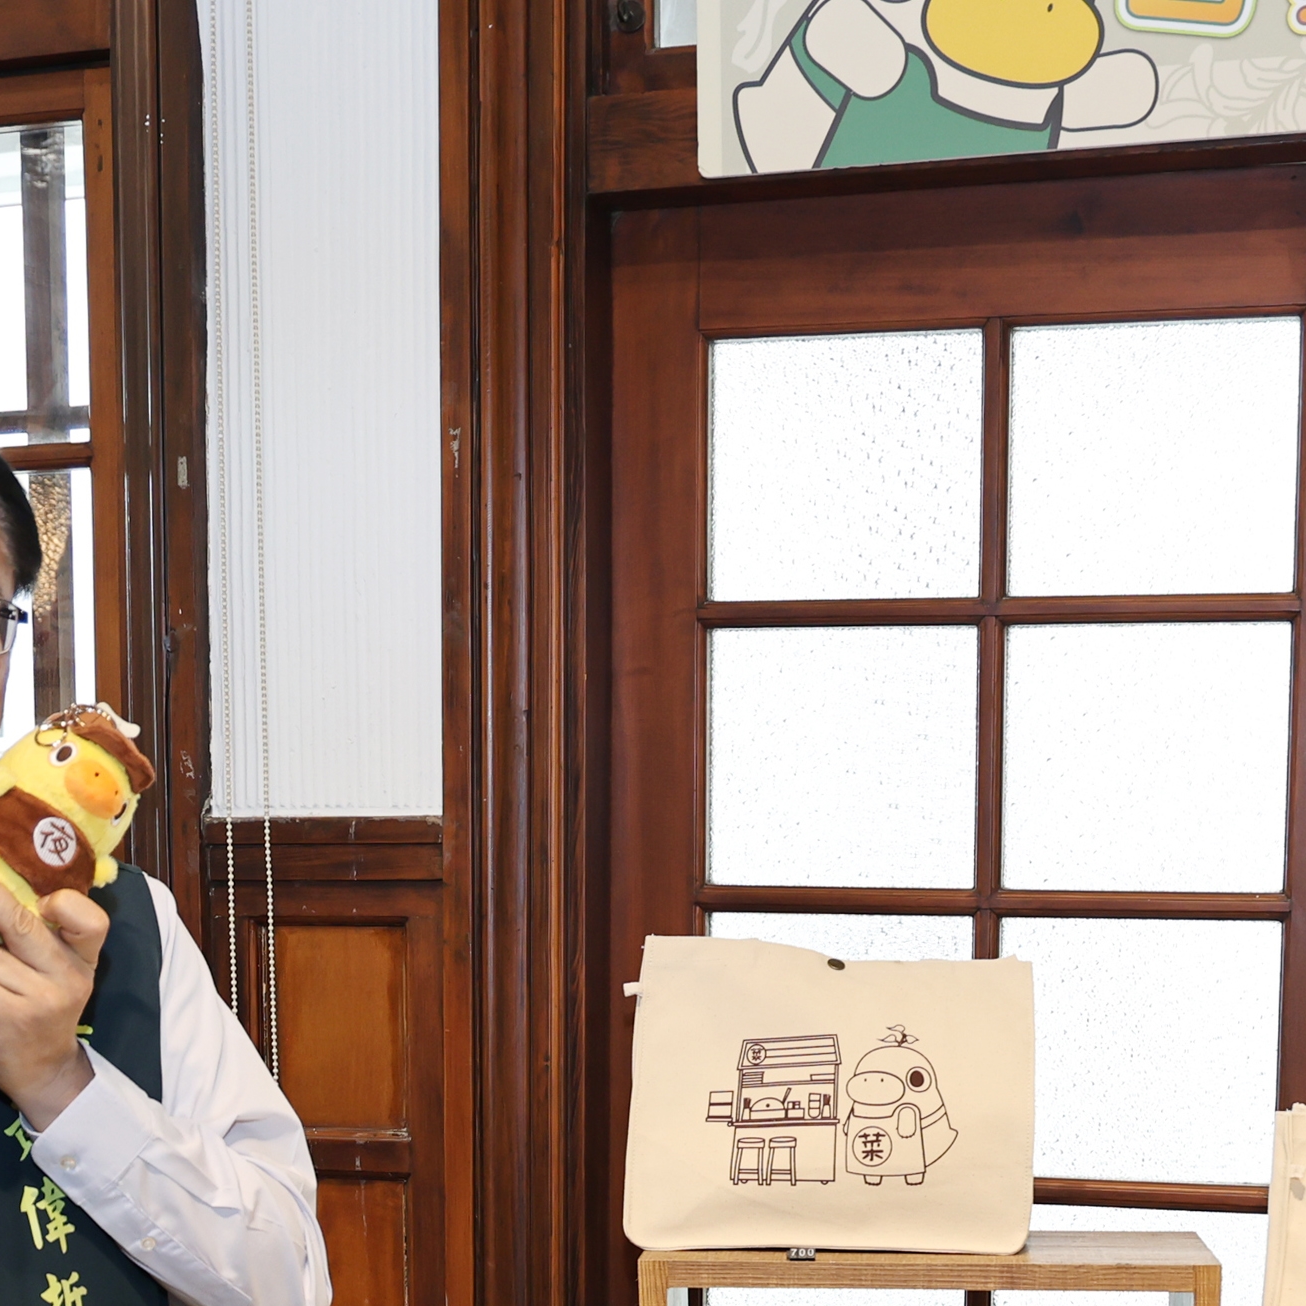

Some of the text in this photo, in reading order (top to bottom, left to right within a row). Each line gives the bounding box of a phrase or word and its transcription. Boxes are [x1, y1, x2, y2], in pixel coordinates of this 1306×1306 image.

[39, 821, 74, 864] 夜
[858, 1132, 886, 1162] 菜
[789, 1248, 815, 1258] 700
